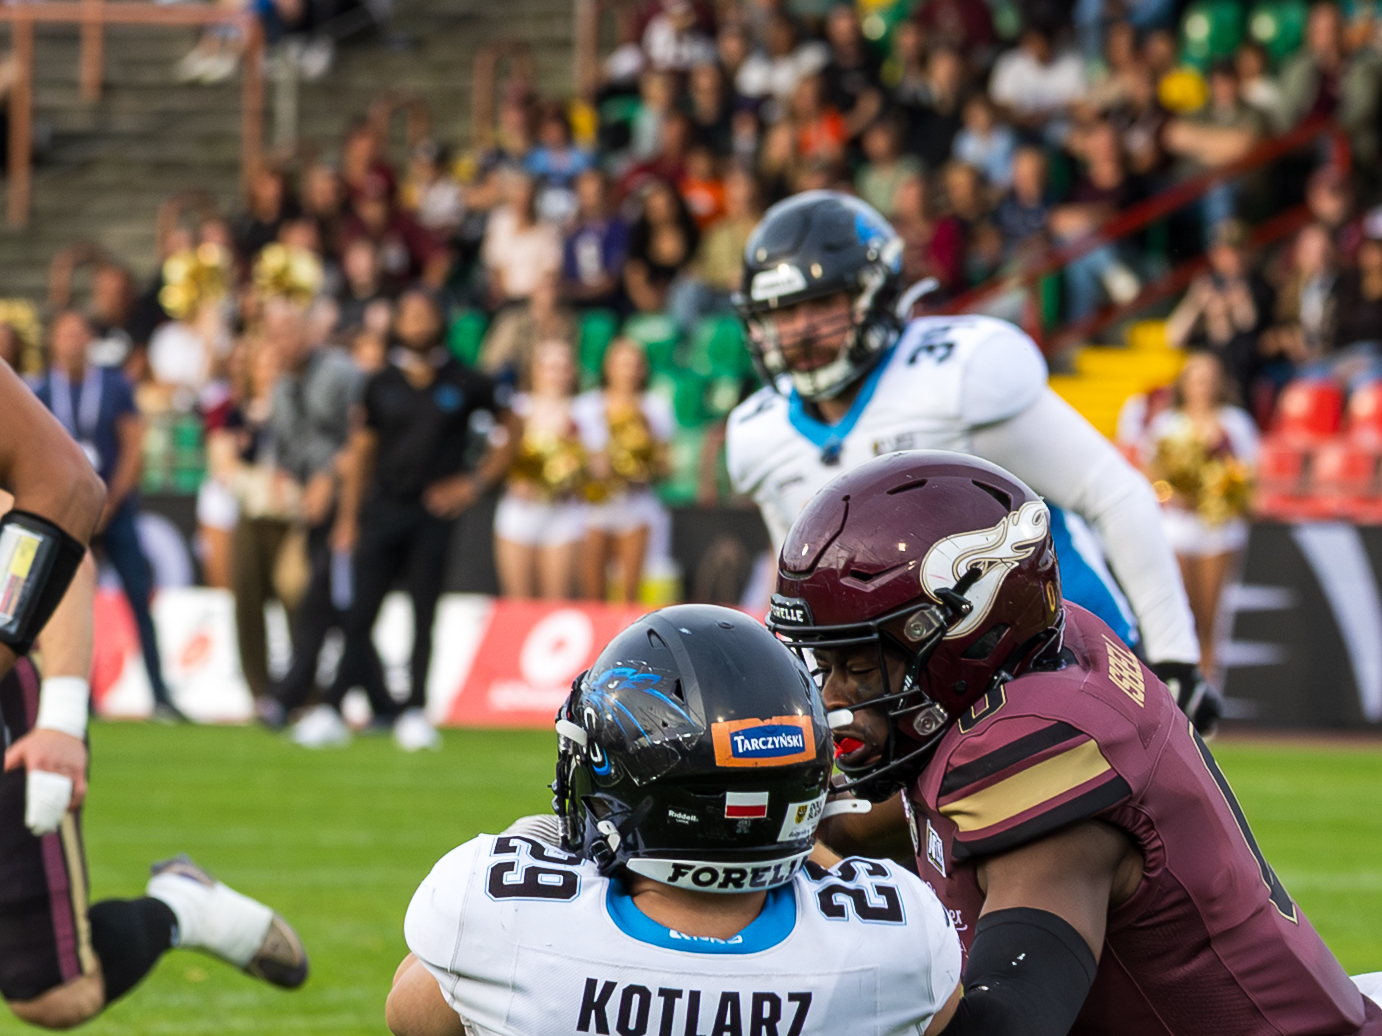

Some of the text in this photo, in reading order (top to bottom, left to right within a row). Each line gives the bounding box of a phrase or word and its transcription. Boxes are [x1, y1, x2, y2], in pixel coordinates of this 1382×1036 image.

[1101, 632, 1146, 709] ISBELL
[734, 733, 803, 754] TARCZYŃSKI
[485, 835, 587, 903] 29
[667, 855, 808, 890] FORELL
